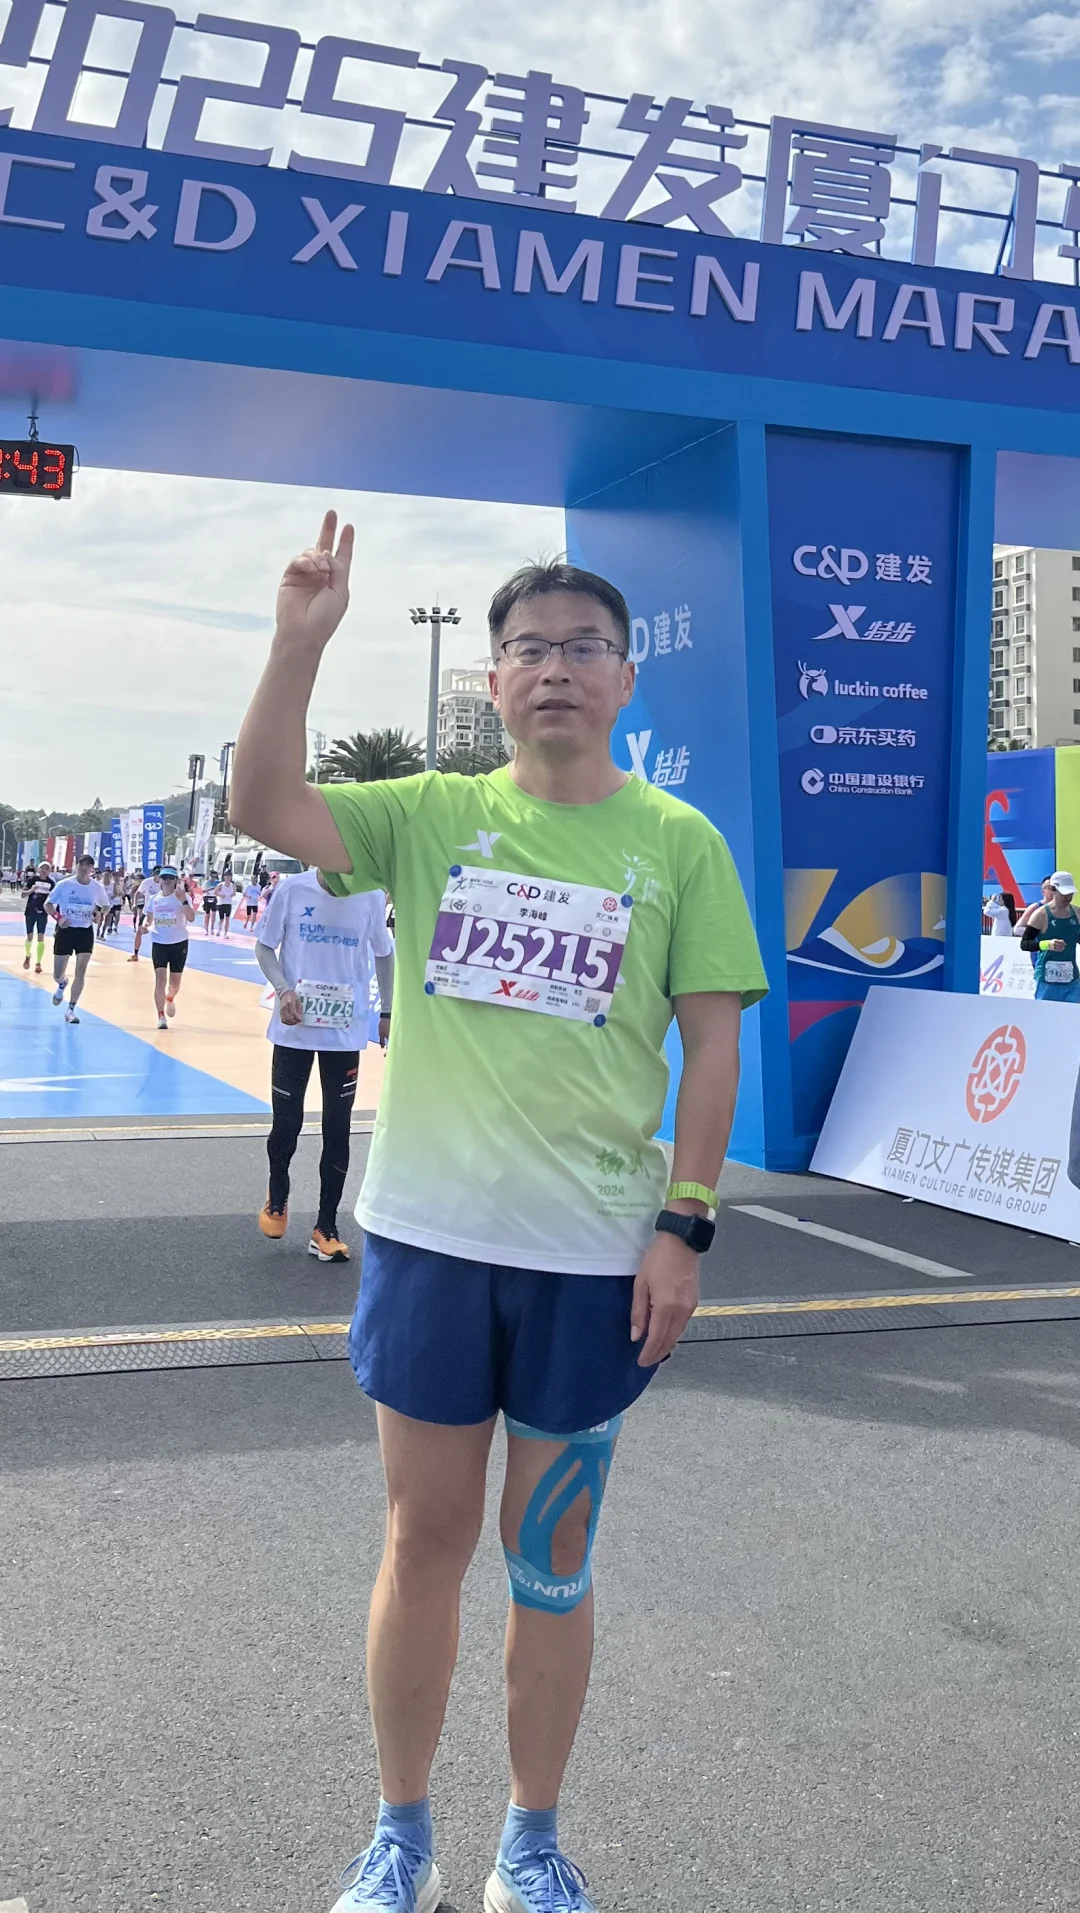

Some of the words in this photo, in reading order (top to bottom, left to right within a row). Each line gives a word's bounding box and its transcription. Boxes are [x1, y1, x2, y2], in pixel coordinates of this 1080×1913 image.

[291, 196, 761, 323] XIAMEN
[795, 269, 1080, 365] MARA
[0, 448, 66, 490] :43
[793, 544, 869, 586] C&D
[874, 552, 933, 585] 建发
[653, 603, 693, 659] 建发
[860, 619, 916, 643] 特步
[834, 679, 879, 699] luckin
[882, 683, 928, 700] coffee
[838, 726, 917, 748] 京东买药
[651, 744, 691, 788] 特步
[828, 772, 925, 788] 中国建设银行
[828, 784, 850, 794] China
[851, 785, 894, 796] Construction
[894, 786, 913, 796] Bank
[506, 882, 541, 901] C&D
[543, 889, 571, 906] 建发
[300, 923, 325, 934] RUN
[300, 933, 359, 948] TOGETHER
[441, 914, 613, 989] J25215
[886, 1126, 1062, 1199] 厦门文广传媒集团
[596, 1184, 625, 1196] 2024
[881, 1164, 918, 1185] XIAMEN
[919, 1174, 966, 1198] CULTURE
[968, 1187, 1003, 1207] MEDIA
[1005, 1196, 1048, 1216] GROUP
